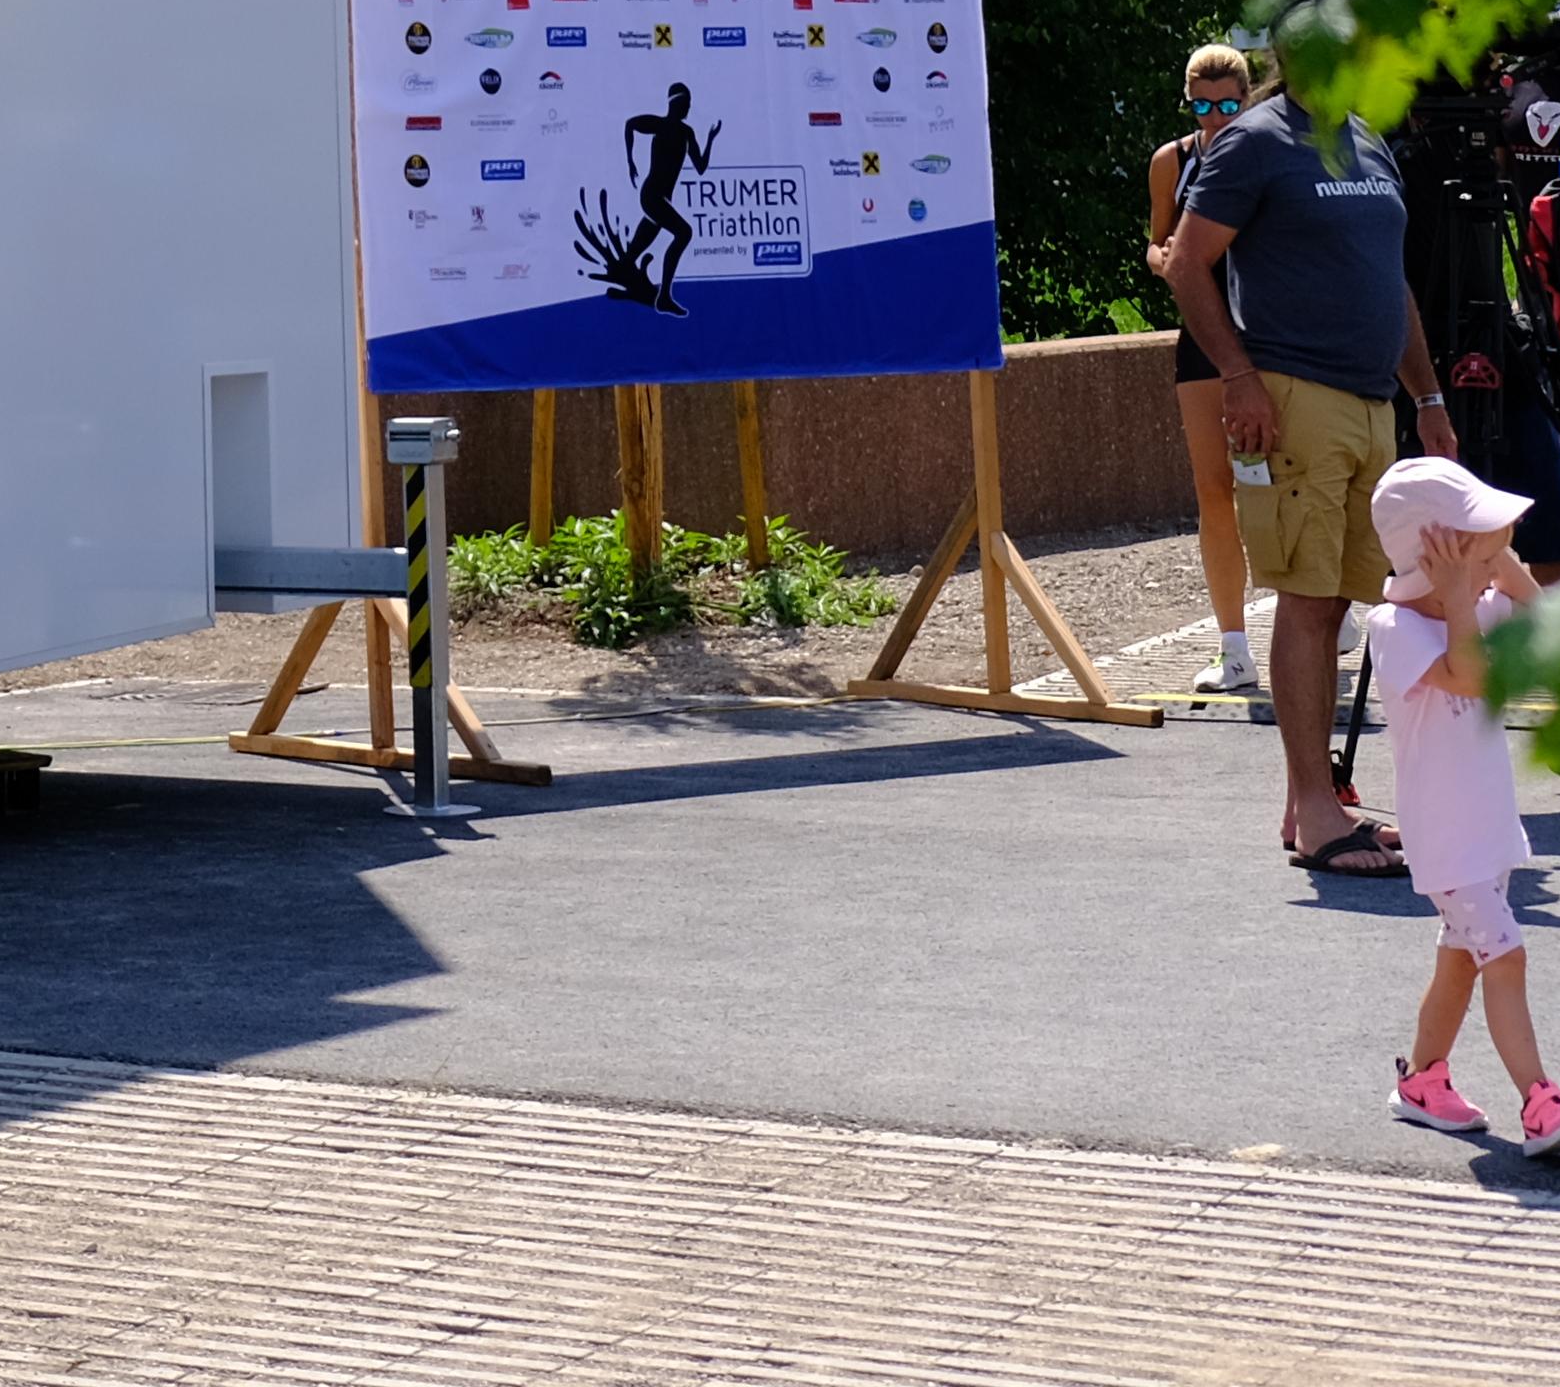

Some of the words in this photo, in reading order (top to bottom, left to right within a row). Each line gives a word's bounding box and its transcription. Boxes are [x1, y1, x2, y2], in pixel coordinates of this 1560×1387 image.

[549, 27, 584, 40] pure
[705, 27, 743, 40] pure
[483, 160, 523, 173] pure
[680, 178, 799, 208] TRUMER
[1314, 174, 1397, 199] numotion
[692, 210, 801, 239] Triathlon
[693, 245, 736, 258] presented
[737, 244, 748, 257] by
[755, 242, 799, 257] pure
